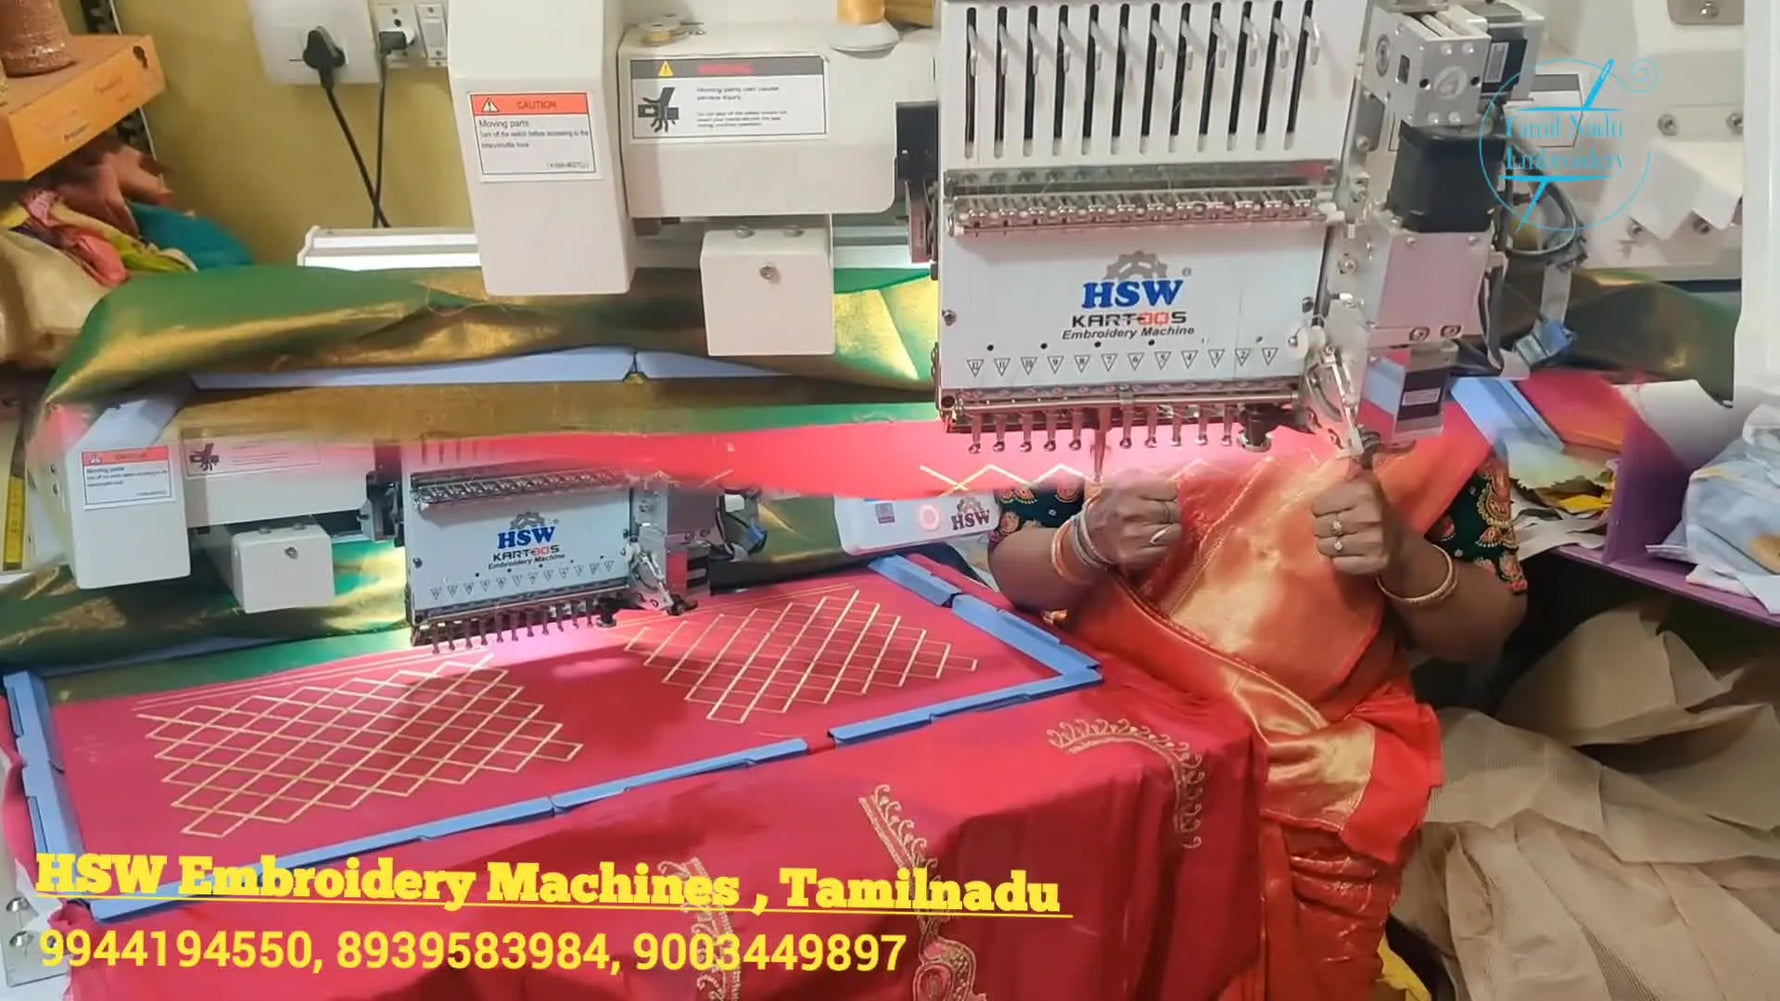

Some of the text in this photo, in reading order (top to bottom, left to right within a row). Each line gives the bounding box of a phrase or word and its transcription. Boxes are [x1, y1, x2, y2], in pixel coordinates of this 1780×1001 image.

[516, 100, 557, 110] CAUTION
[479, 119, 529, 128] Moving parts
[1082, 279, 1184, 309] HSW
[1062, 325, 1195, 340] Embroidery Machine
[951, 509, 991, 531] HSW
[497, 526, 555, 549] HSW
[488, 553, 565, 570] Embroidery Machine
